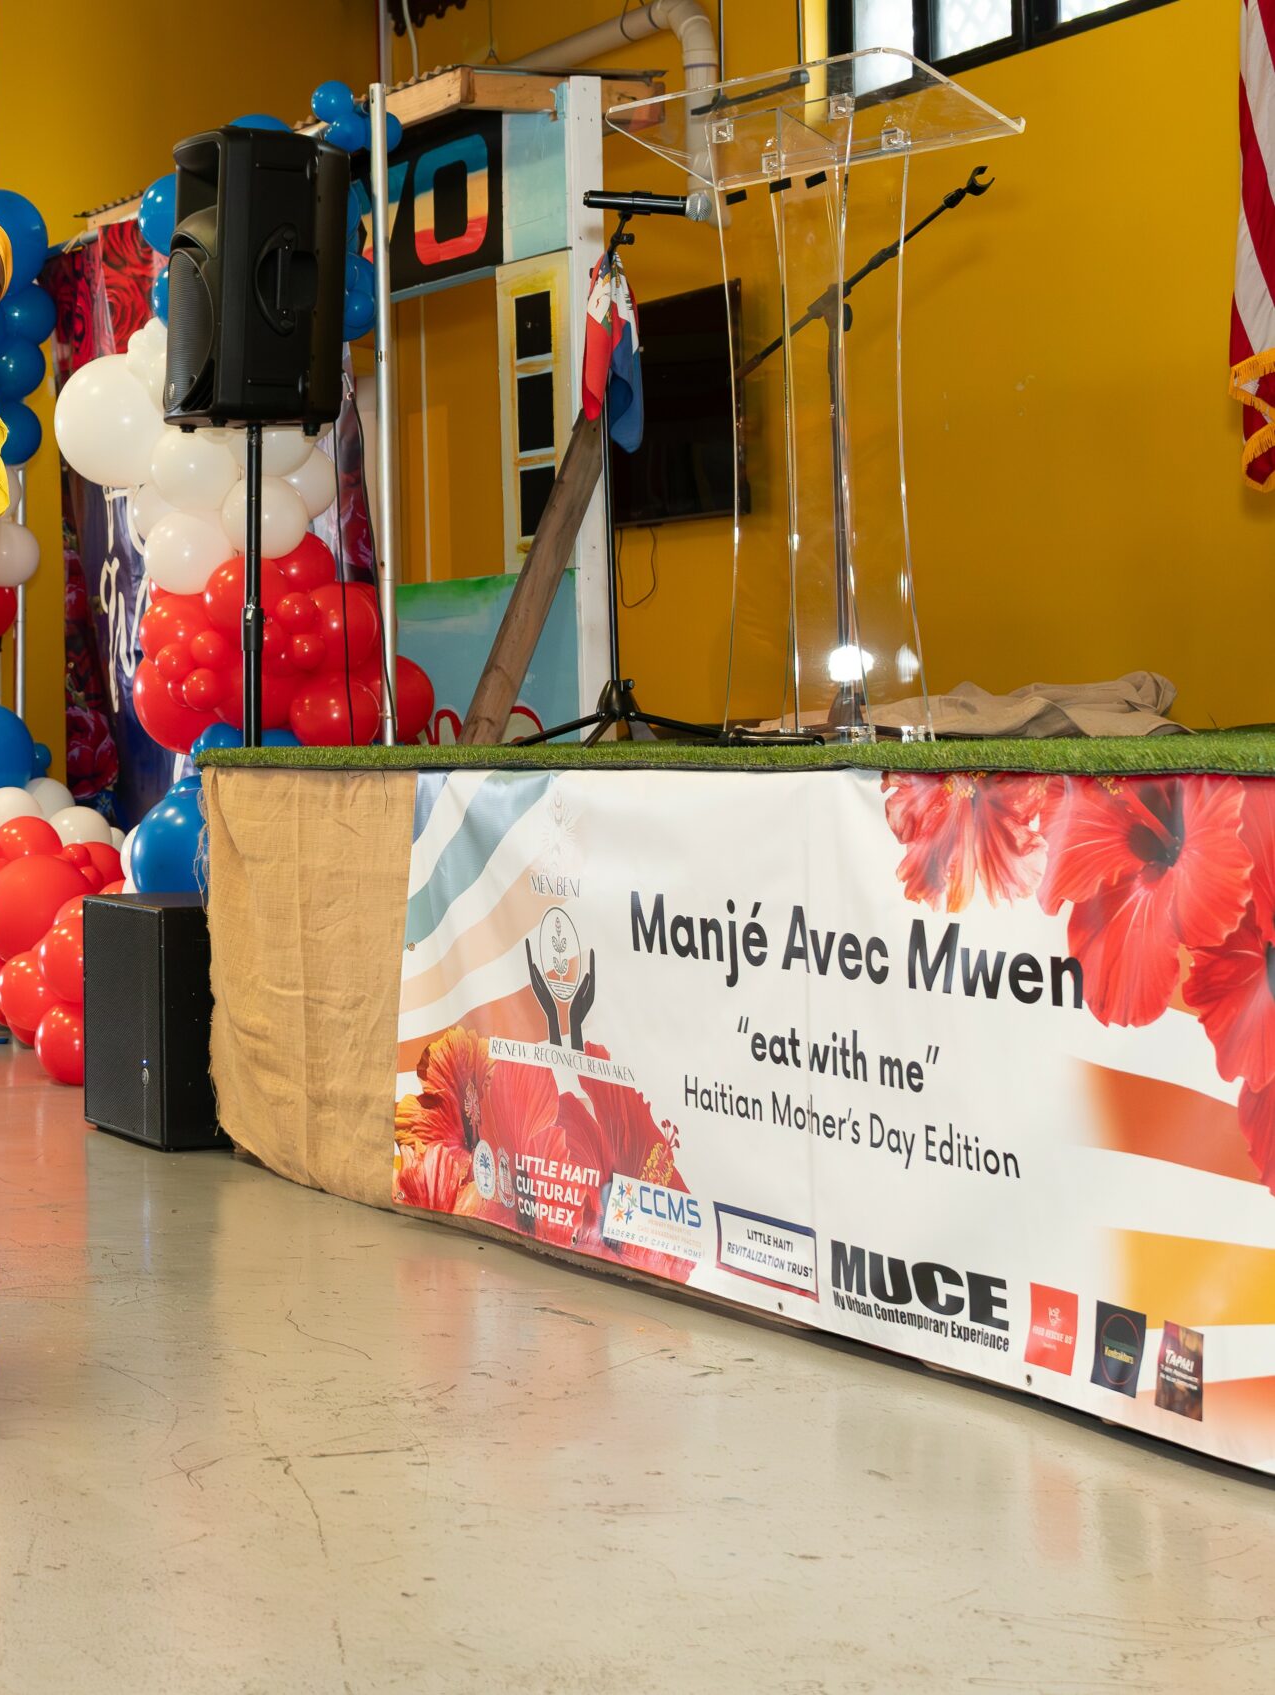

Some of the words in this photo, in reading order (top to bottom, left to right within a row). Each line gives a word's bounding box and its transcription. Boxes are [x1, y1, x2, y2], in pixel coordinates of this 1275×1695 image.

[631, 891, 768, 987] Manjé
[781, 905, 889, 984] Avec
[908, 919, 1083, 1009] Mwen
[808, 1030, 868, 1082] with
[685, 1075, 763, 1121] Haitian
[870, 1113, 915, 1169] Day
[925, 1123, 1020, 1178] Edition
[515, 1153, 558, 1178] LITTLE
[560, 1163, 600, 1187] HAITI
[516, 1175, 582, 1206] CULTURAL
[518, 1197, 575, 1227] COMPLEX
[639, 1185, 701, 1228] CCMS
[727, 1242, 785, 1270] REVITALIZATION
[787, 1260, 813, 1279] TRUST
[747, 1229, 771, 1247] LITTLE
[773, 1236, 794, 1253] HAITI
[831, 1239, 1010, 1331] MUCE
[832, 1290, 846, 1310] My
[846, 1294, 873, 1318] Urban
[874, 1303, 949, 1338] Contemporary
[951, 1320, 1010, 1352] Experience
